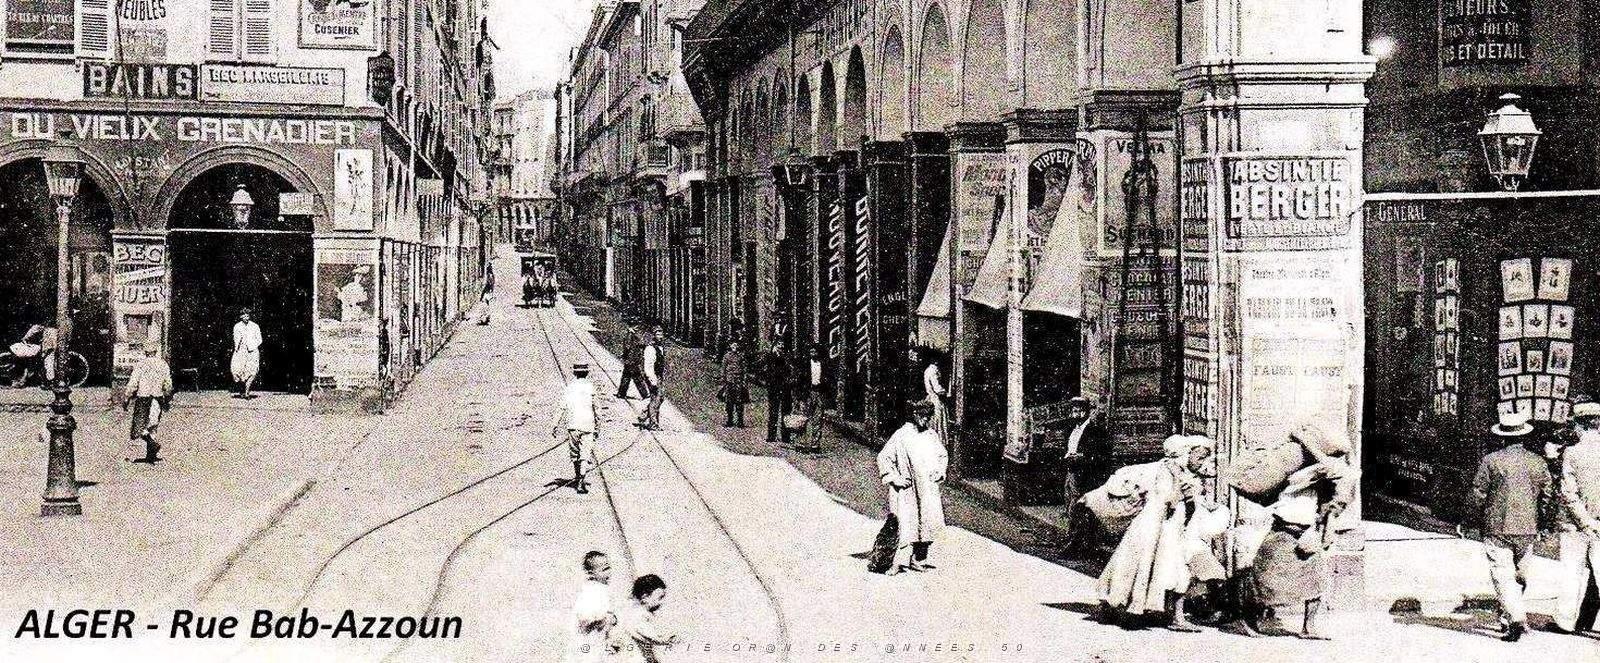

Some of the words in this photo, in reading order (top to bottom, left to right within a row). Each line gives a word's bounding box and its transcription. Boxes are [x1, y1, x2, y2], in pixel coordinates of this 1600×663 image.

[314, 23, 360, 35] CUSENIER
[1457, 44, 1472, 60] ET
[87, 63, 194, 98] BAINS
[11, 112, 50, 139] DU
[72, 114, 162, 141] VIEUX
[177, 117, 357, 145] GRENADIER
[1231, 160, 1343, 184] ABSINTHE
[1230, 184, 1346, 221] BERGER
[115, 244, 164, 264] BEC
[113, 284, 166, 305] AUER
